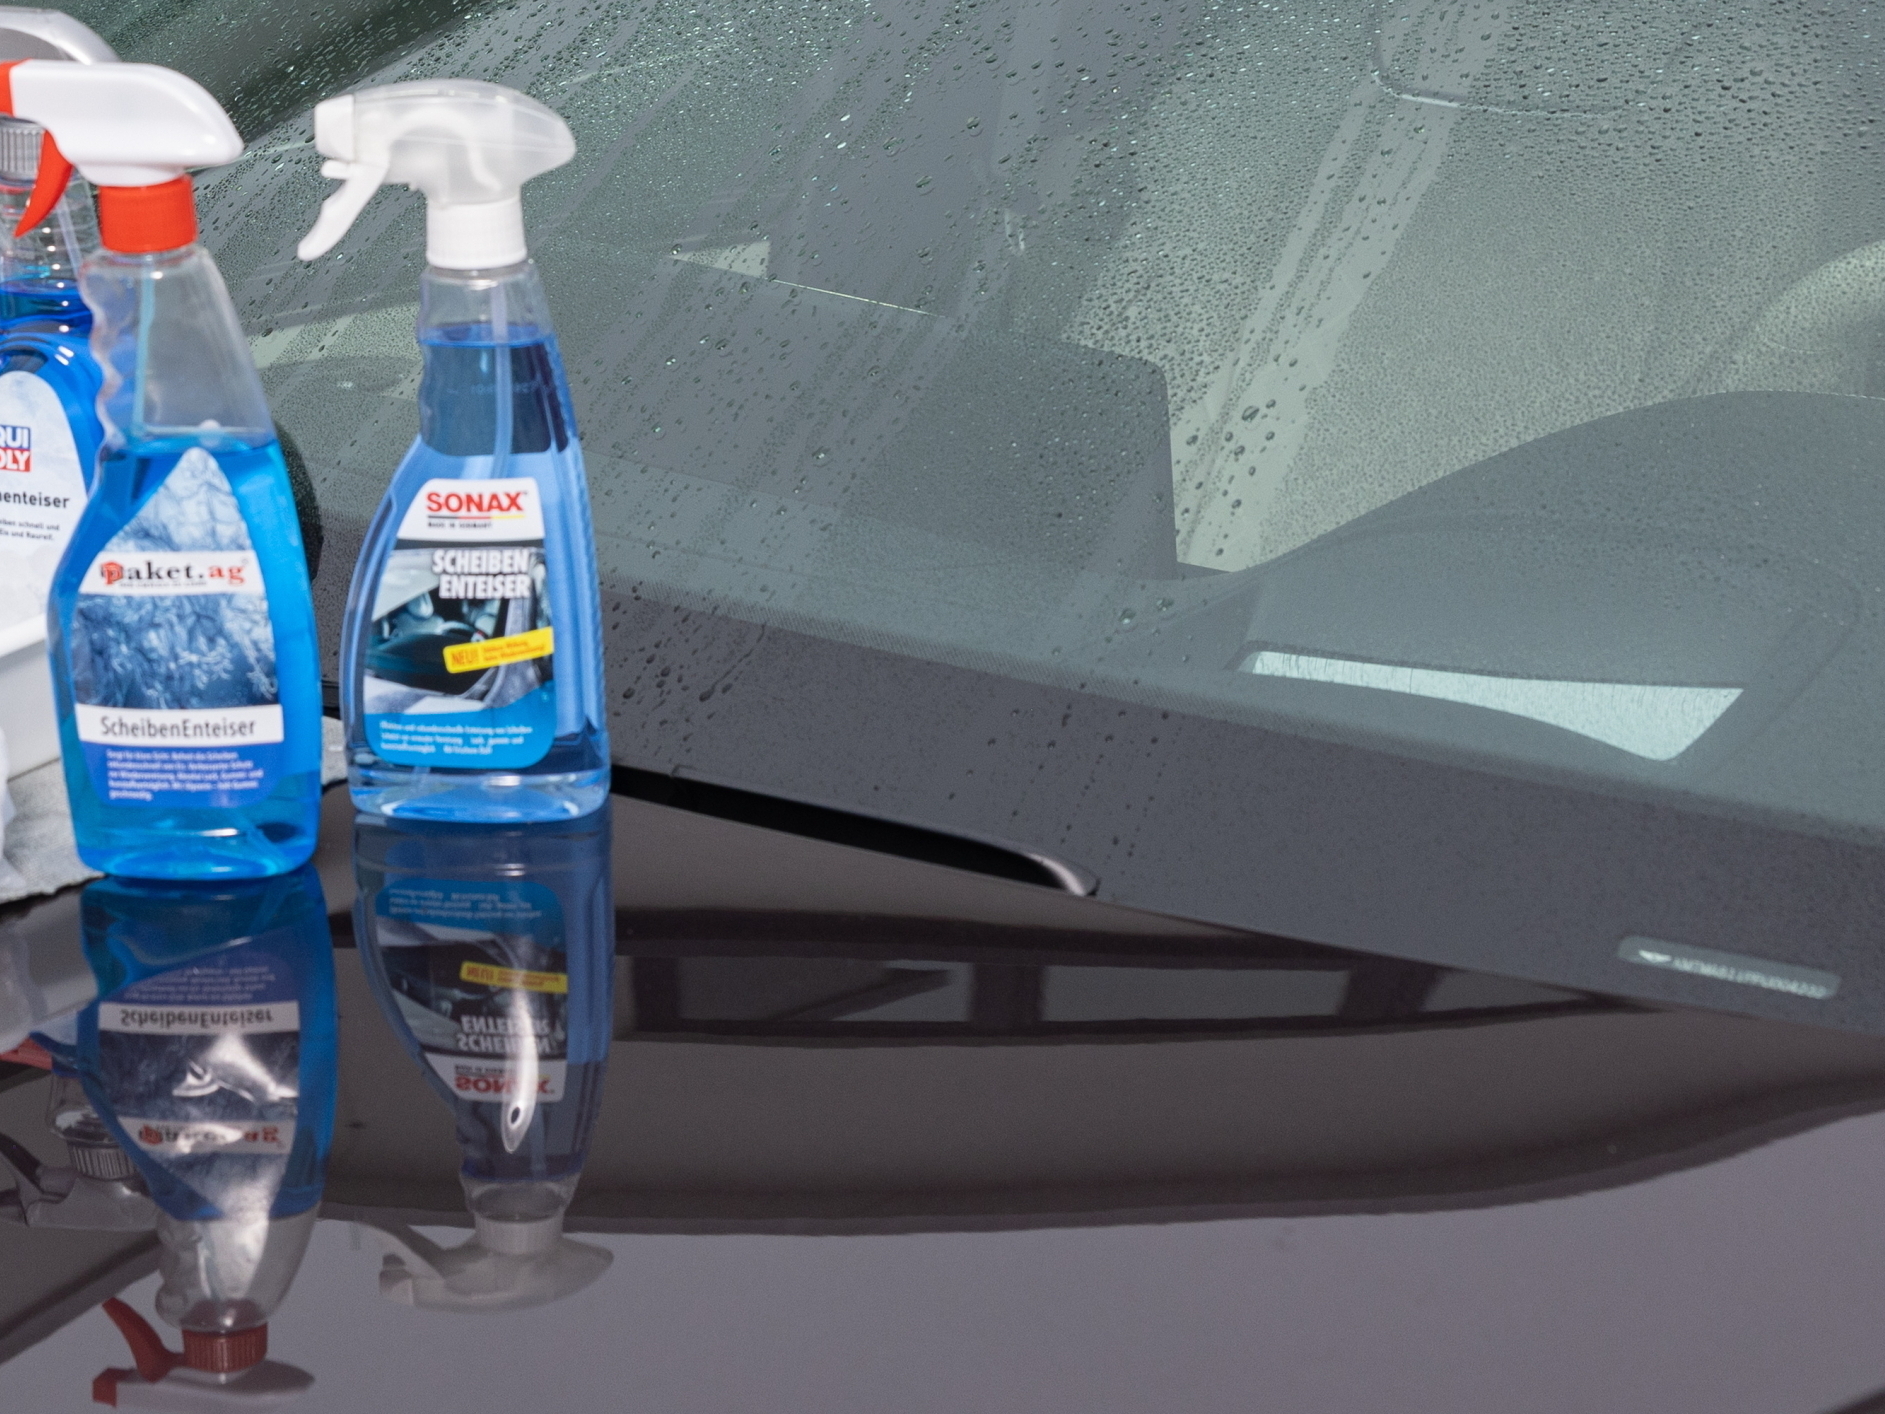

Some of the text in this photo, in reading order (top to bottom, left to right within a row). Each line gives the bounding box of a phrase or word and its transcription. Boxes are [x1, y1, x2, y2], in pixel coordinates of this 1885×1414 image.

[426, 491, 523, 513] SONAX
[432, 549, 529, 574] SCHEIBEN
[439, 574, 531, 599] ENTEISER
[101, 716, 256, 738] ScheibenEnteiser
